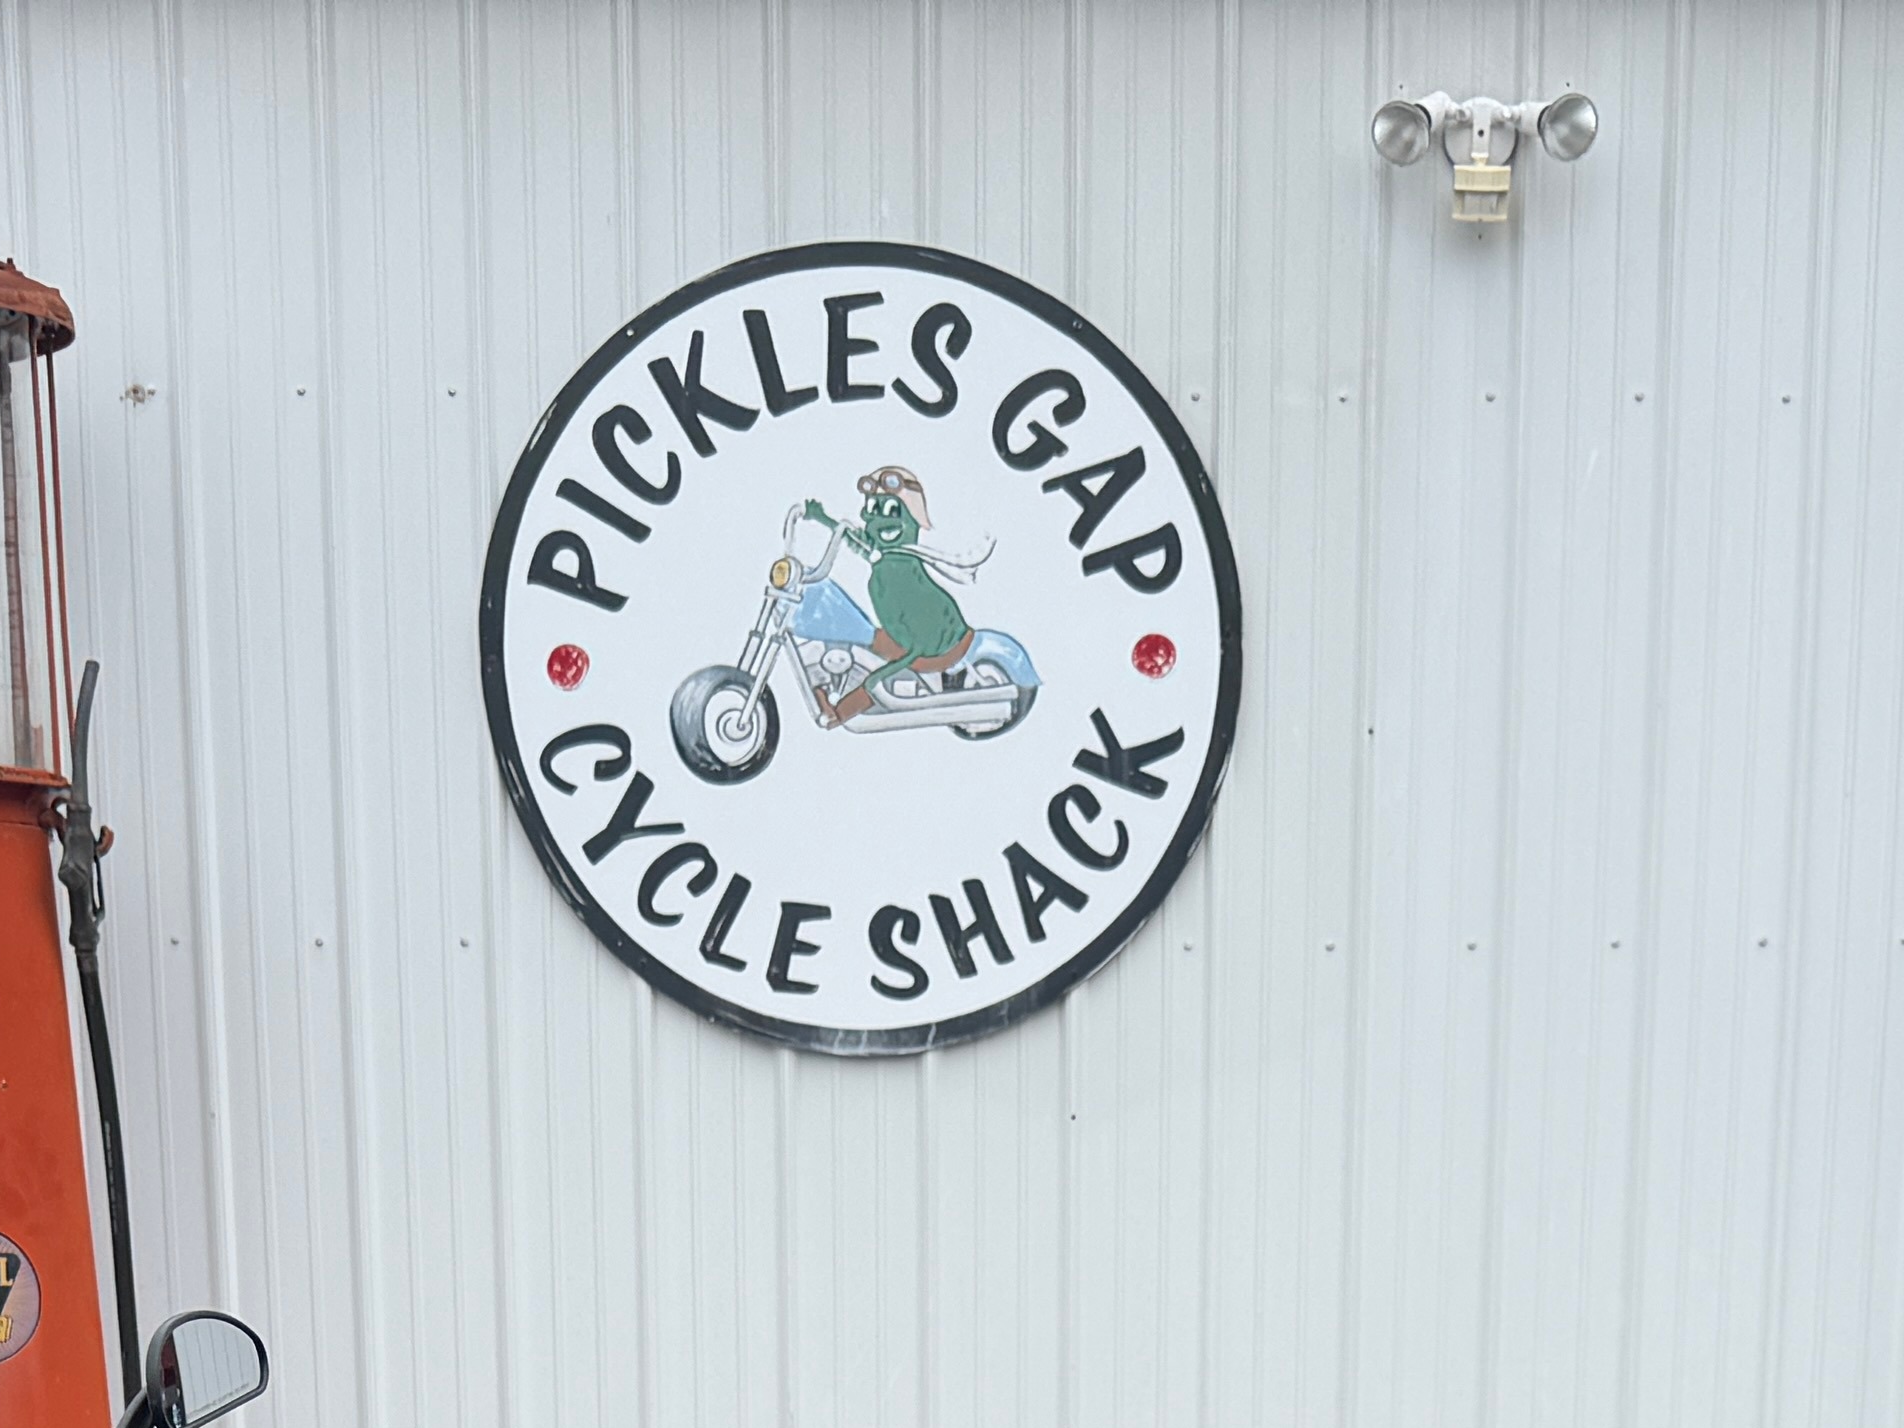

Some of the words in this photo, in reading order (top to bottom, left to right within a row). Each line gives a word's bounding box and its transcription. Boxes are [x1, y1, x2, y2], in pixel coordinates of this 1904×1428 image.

[526, 290, 972, 612] PICKLES
[991, 369, 1183, 595] GAP
[538, 722, 831, 995] CYCLE
[867, 708, 1185, 999] SHACK
